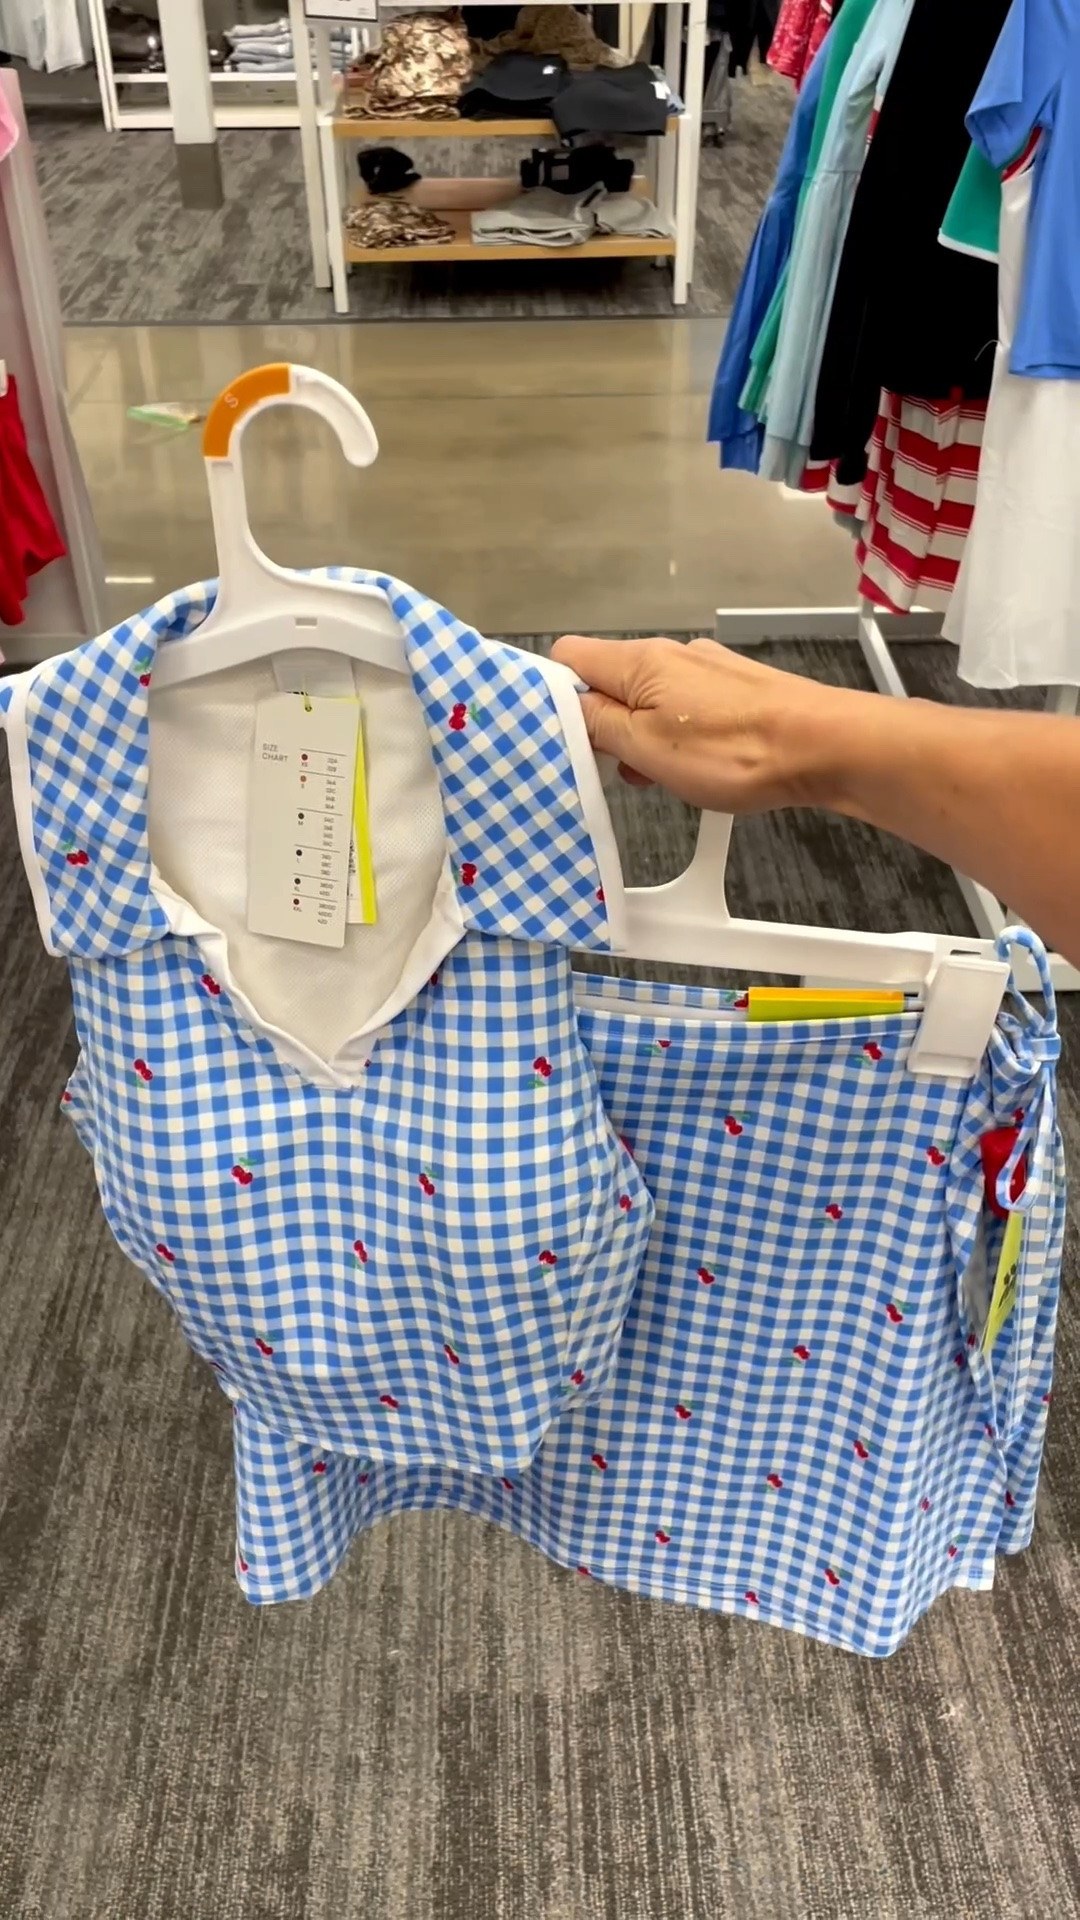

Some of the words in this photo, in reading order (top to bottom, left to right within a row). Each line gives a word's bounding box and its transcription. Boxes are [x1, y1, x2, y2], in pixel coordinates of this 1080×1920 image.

[224, 392, 238, 408] S
[262, 743, 278, 752] SIZE
[262, 752, 288, 762] CHART
